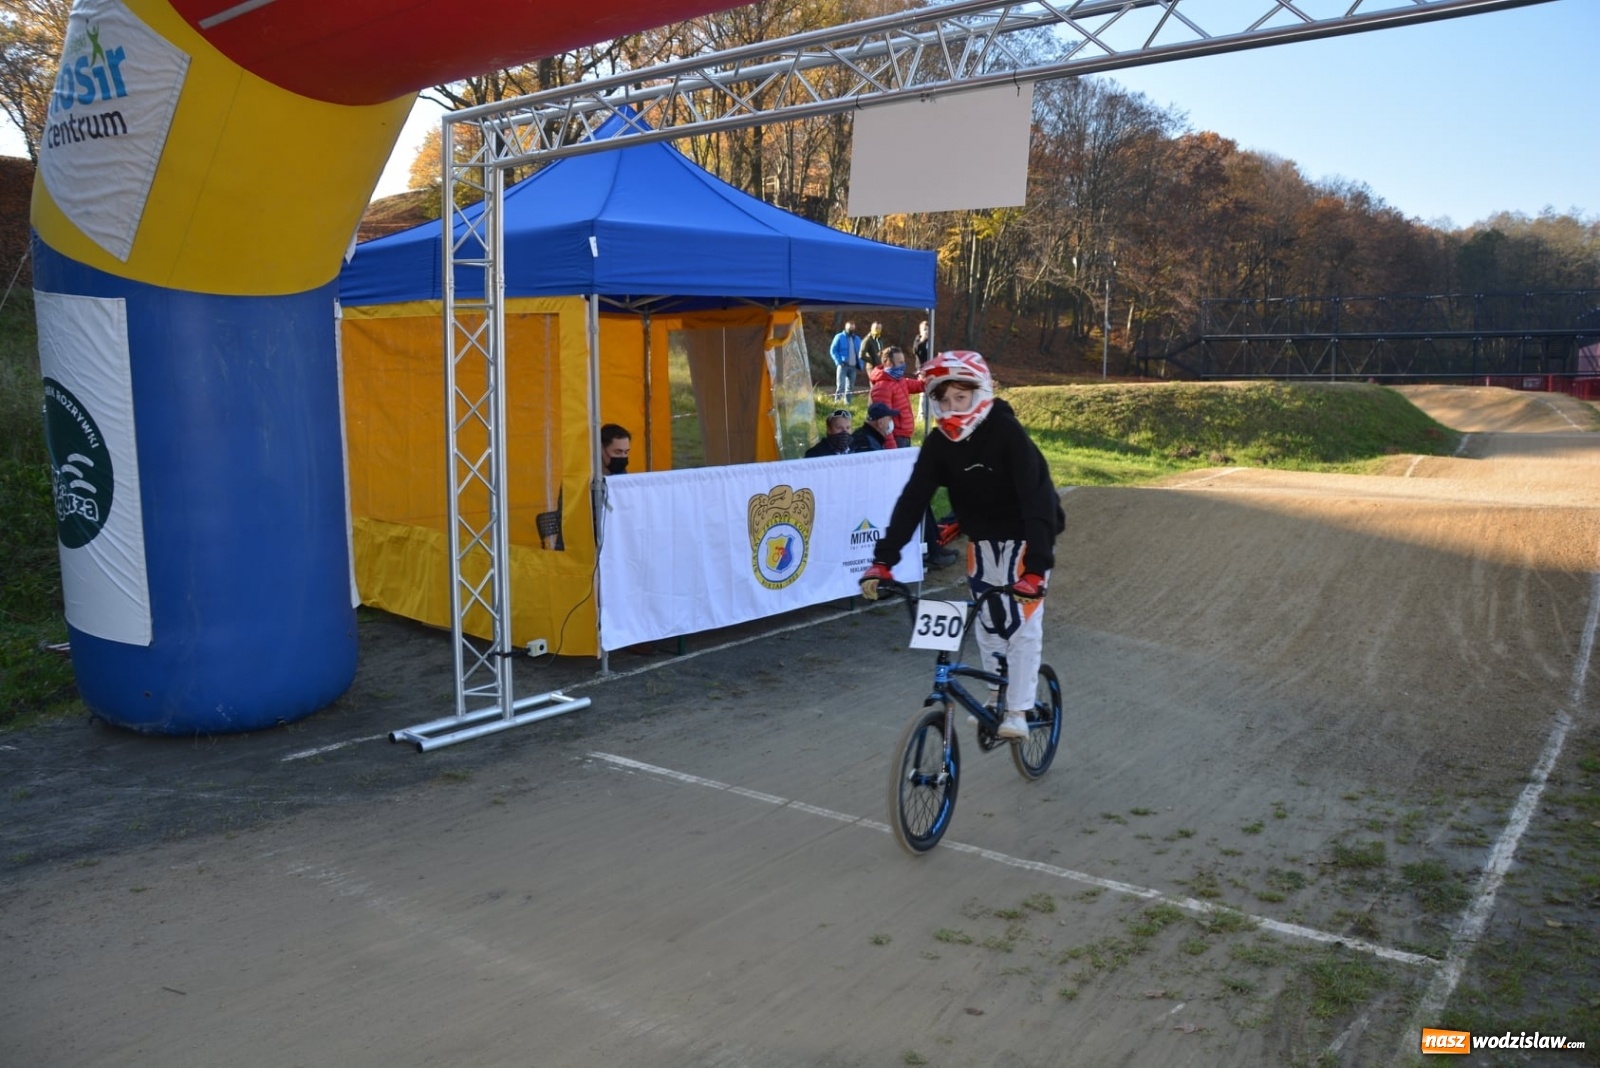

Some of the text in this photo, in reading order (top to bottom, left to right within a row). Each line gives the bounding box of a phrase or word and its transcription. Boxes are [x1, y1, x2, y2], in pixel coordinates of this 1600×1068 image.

[47, 110, 128, 149] centrum
[850, 529, 880, 545] MITKO
[917, 613, 963, 638] 350
